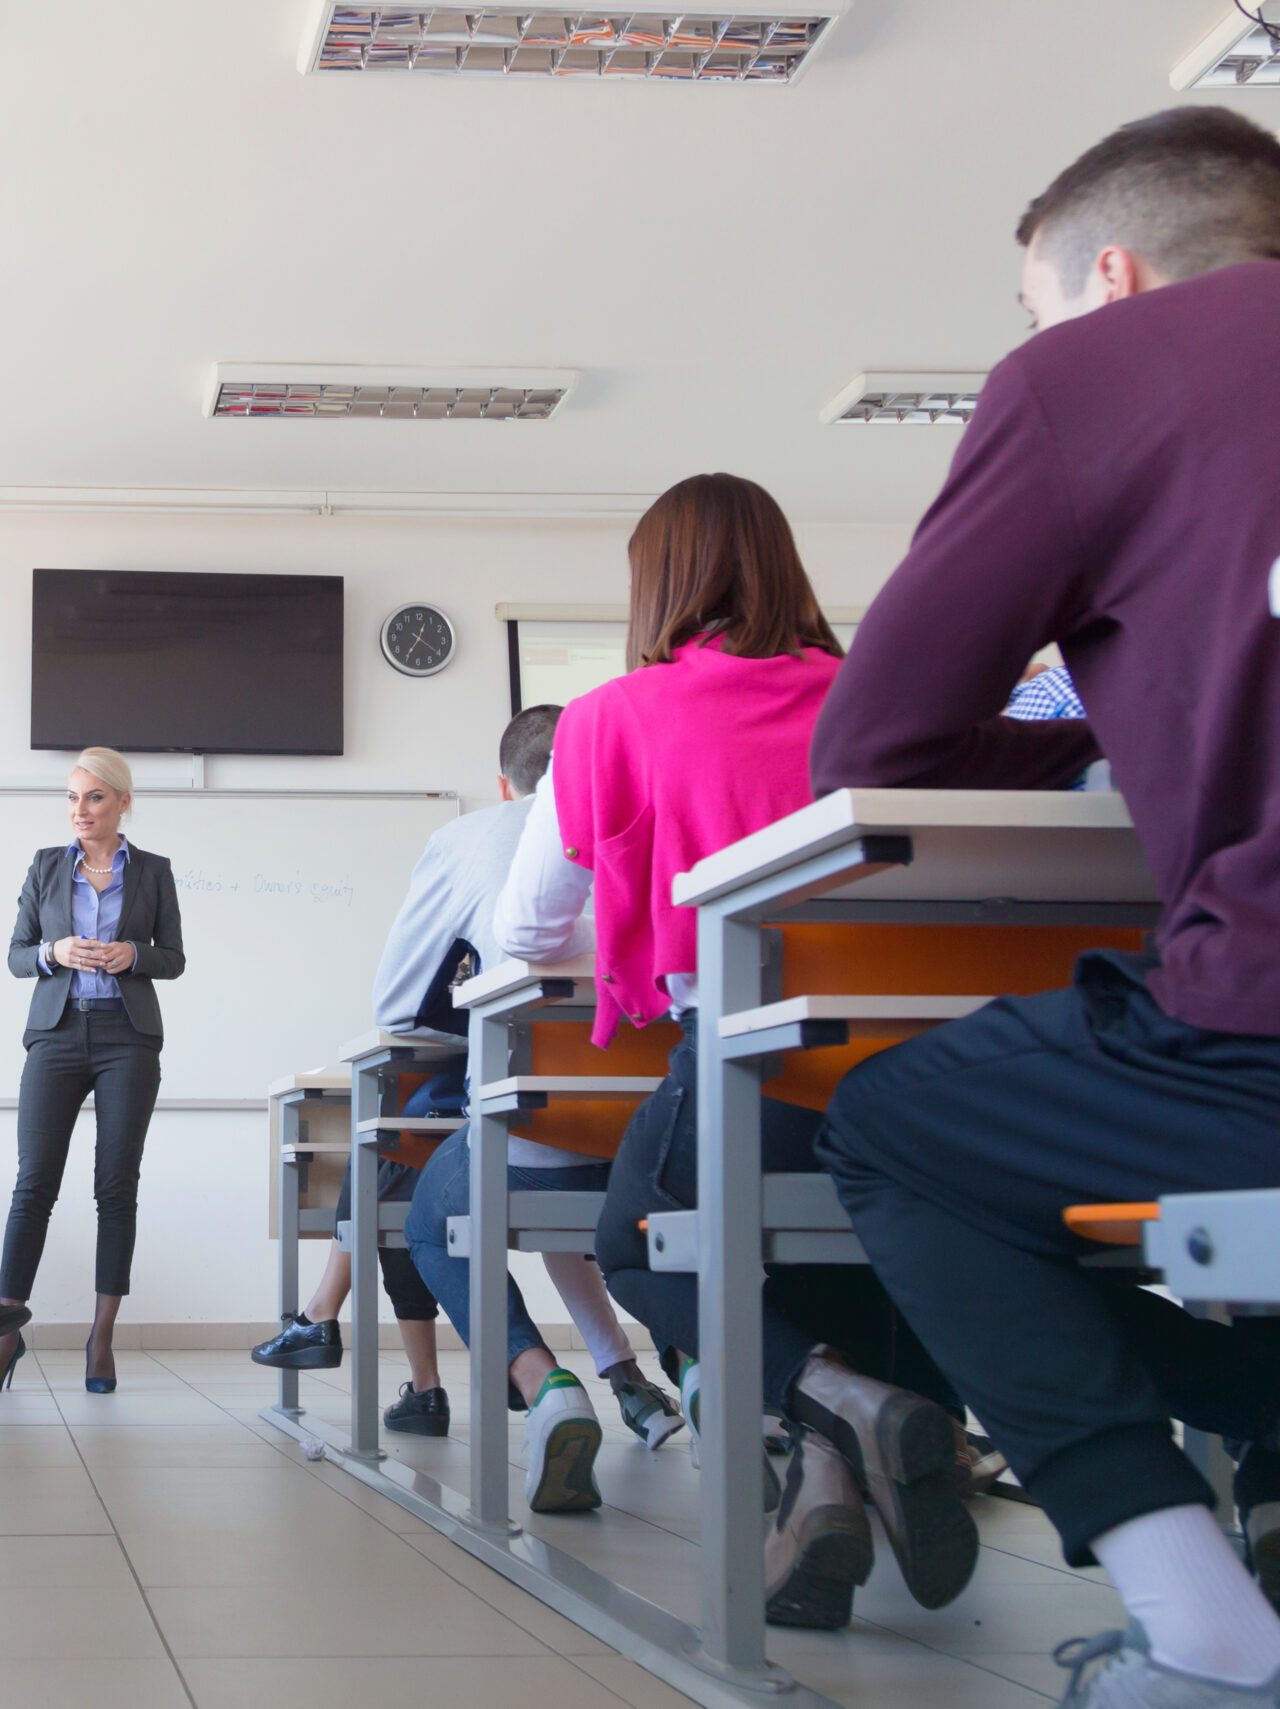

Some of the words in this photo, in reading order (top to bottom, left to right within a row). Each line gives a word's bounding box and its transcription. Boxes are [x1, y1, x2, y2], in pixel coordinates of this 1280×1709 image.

[416, 613, 423, 621] 12
[395, 623, 403, 631] 10
[437, 625, 442, 633] 2
[441, 637, 446, 645] 3
[416, 658, 420, 666] 6
